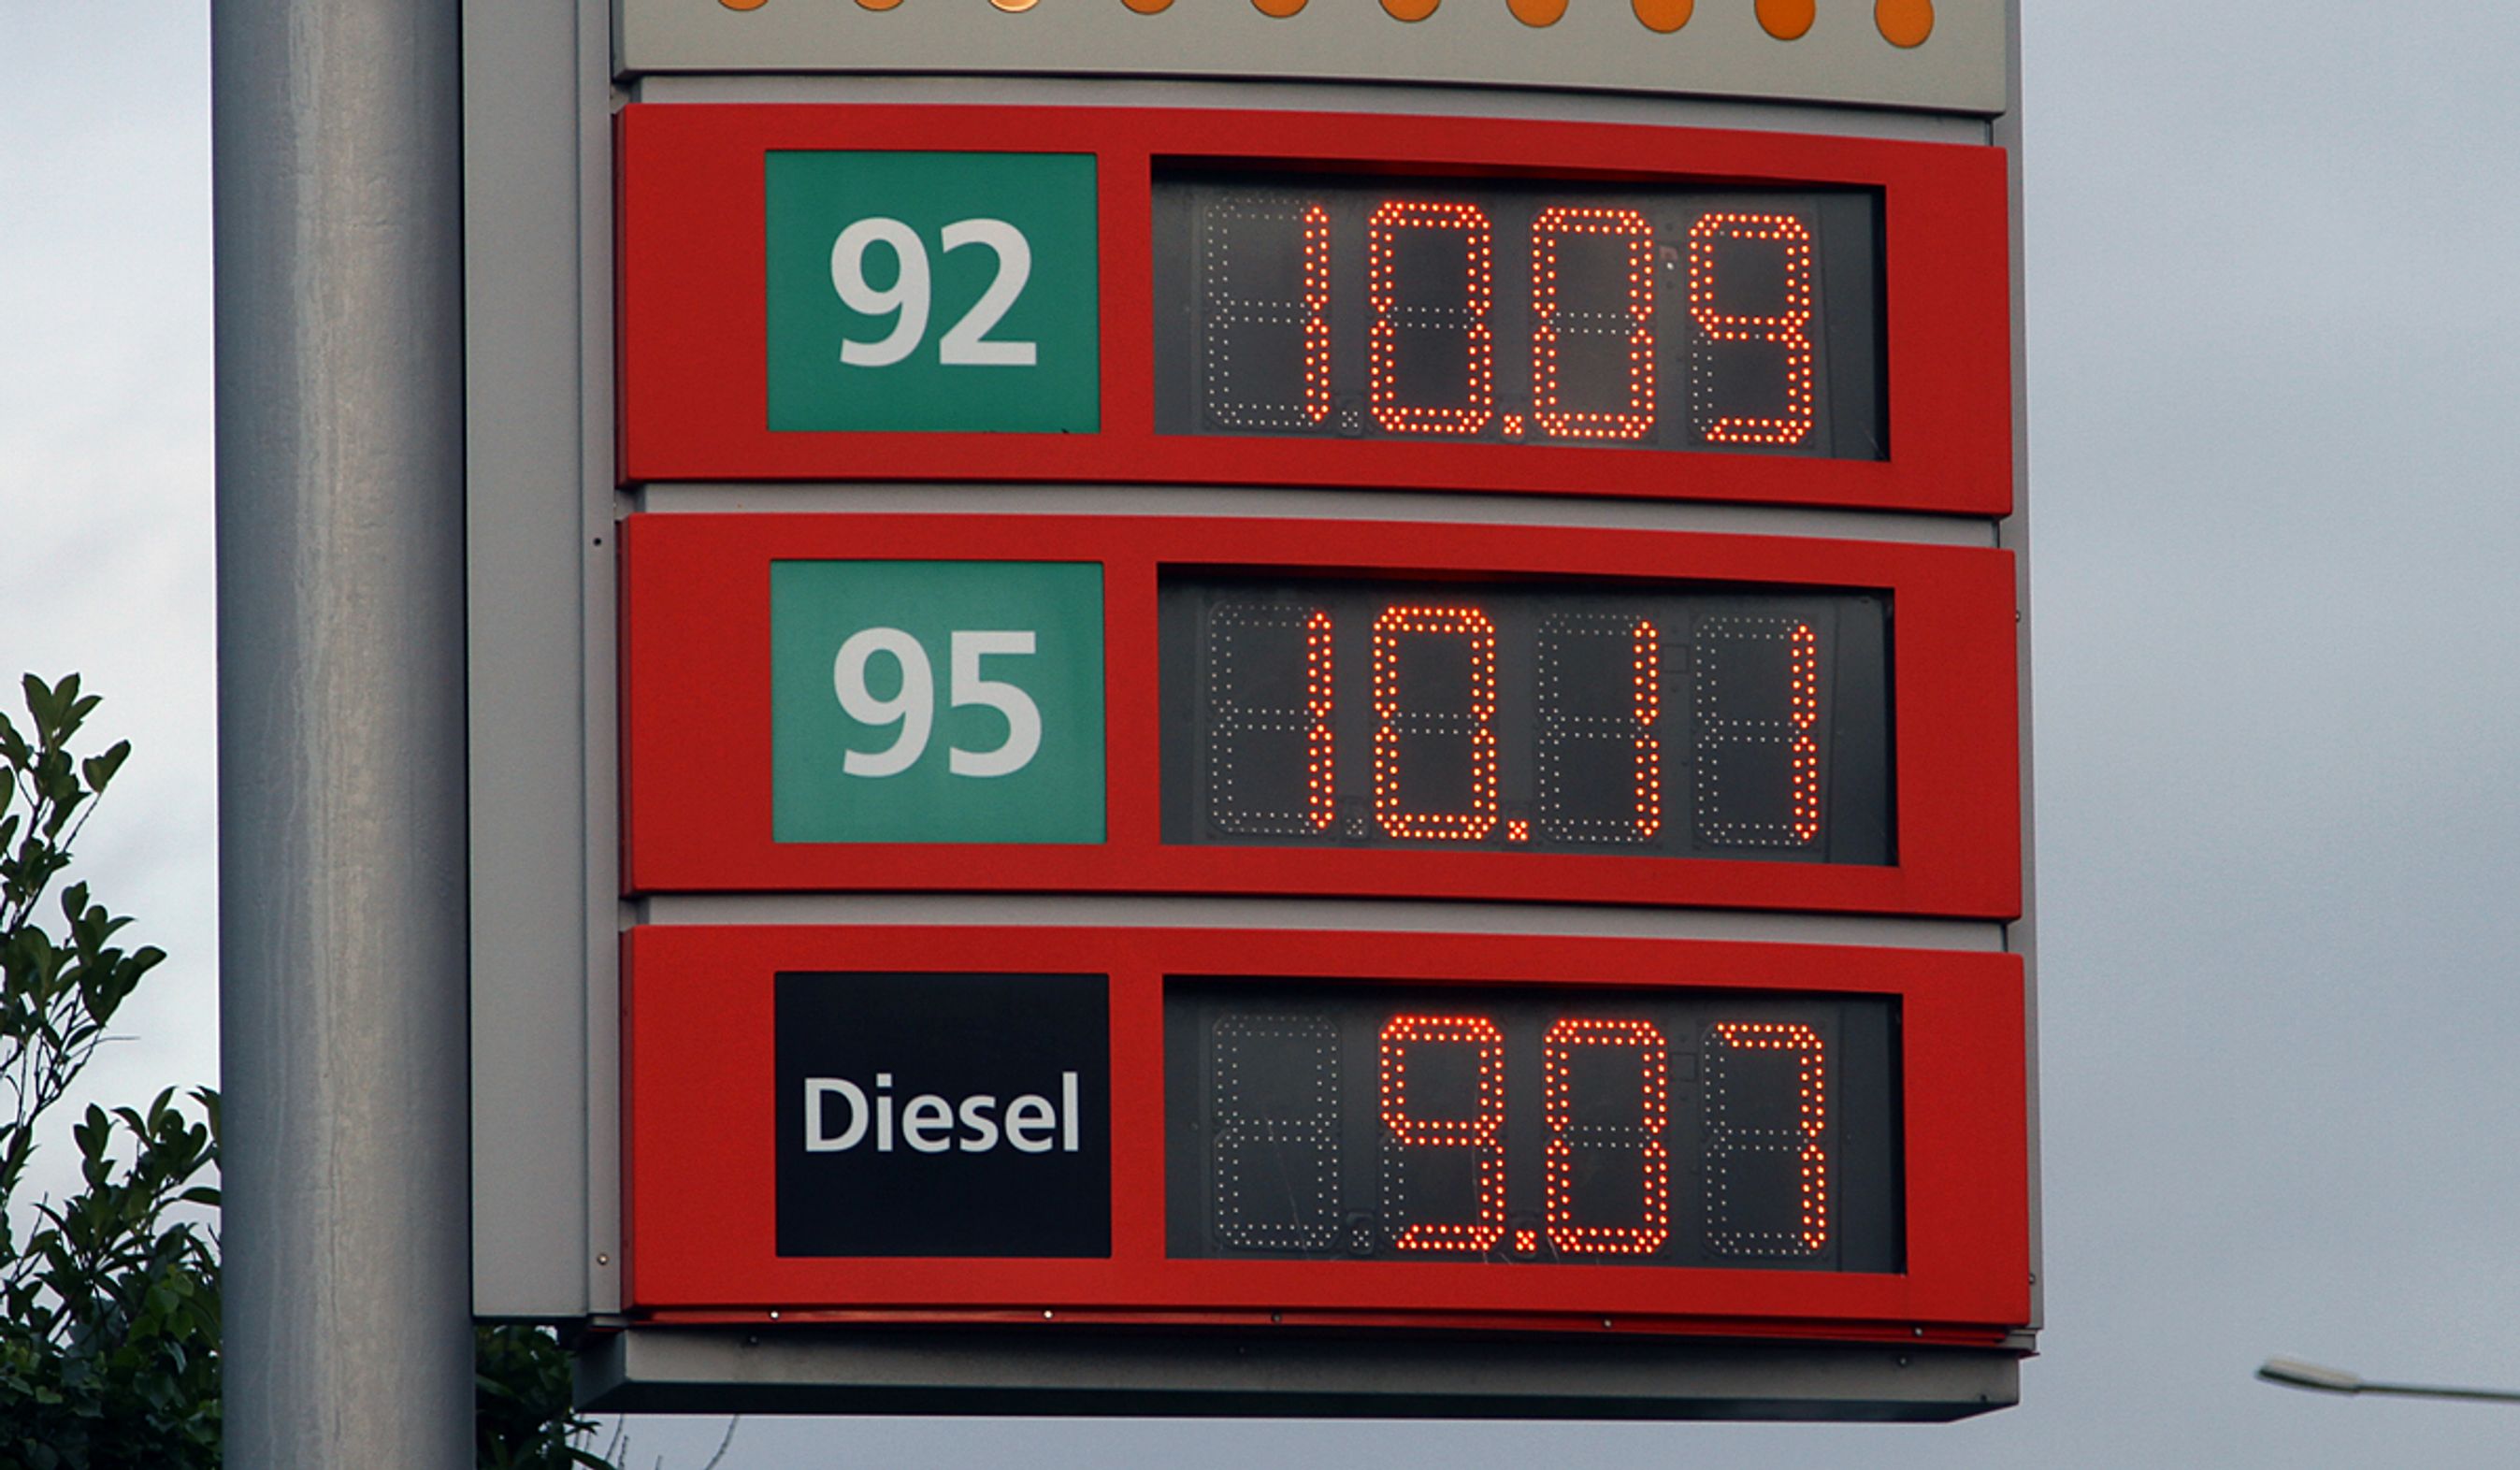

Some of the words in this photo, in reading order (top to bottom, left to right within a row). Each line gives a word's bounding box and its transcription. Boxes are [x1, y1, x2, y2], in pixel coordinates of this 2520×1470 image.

[830, 217, 1037, 368] 92
[1302, 199, 1813, 446] 10.09
[833, 627, 1043, 777] 95
[1306, 605, 1819, 843] 10.11
[803, 1071, 1080, 1154] Diesel
[1378, 1014, 1826, 1255] 9.07
